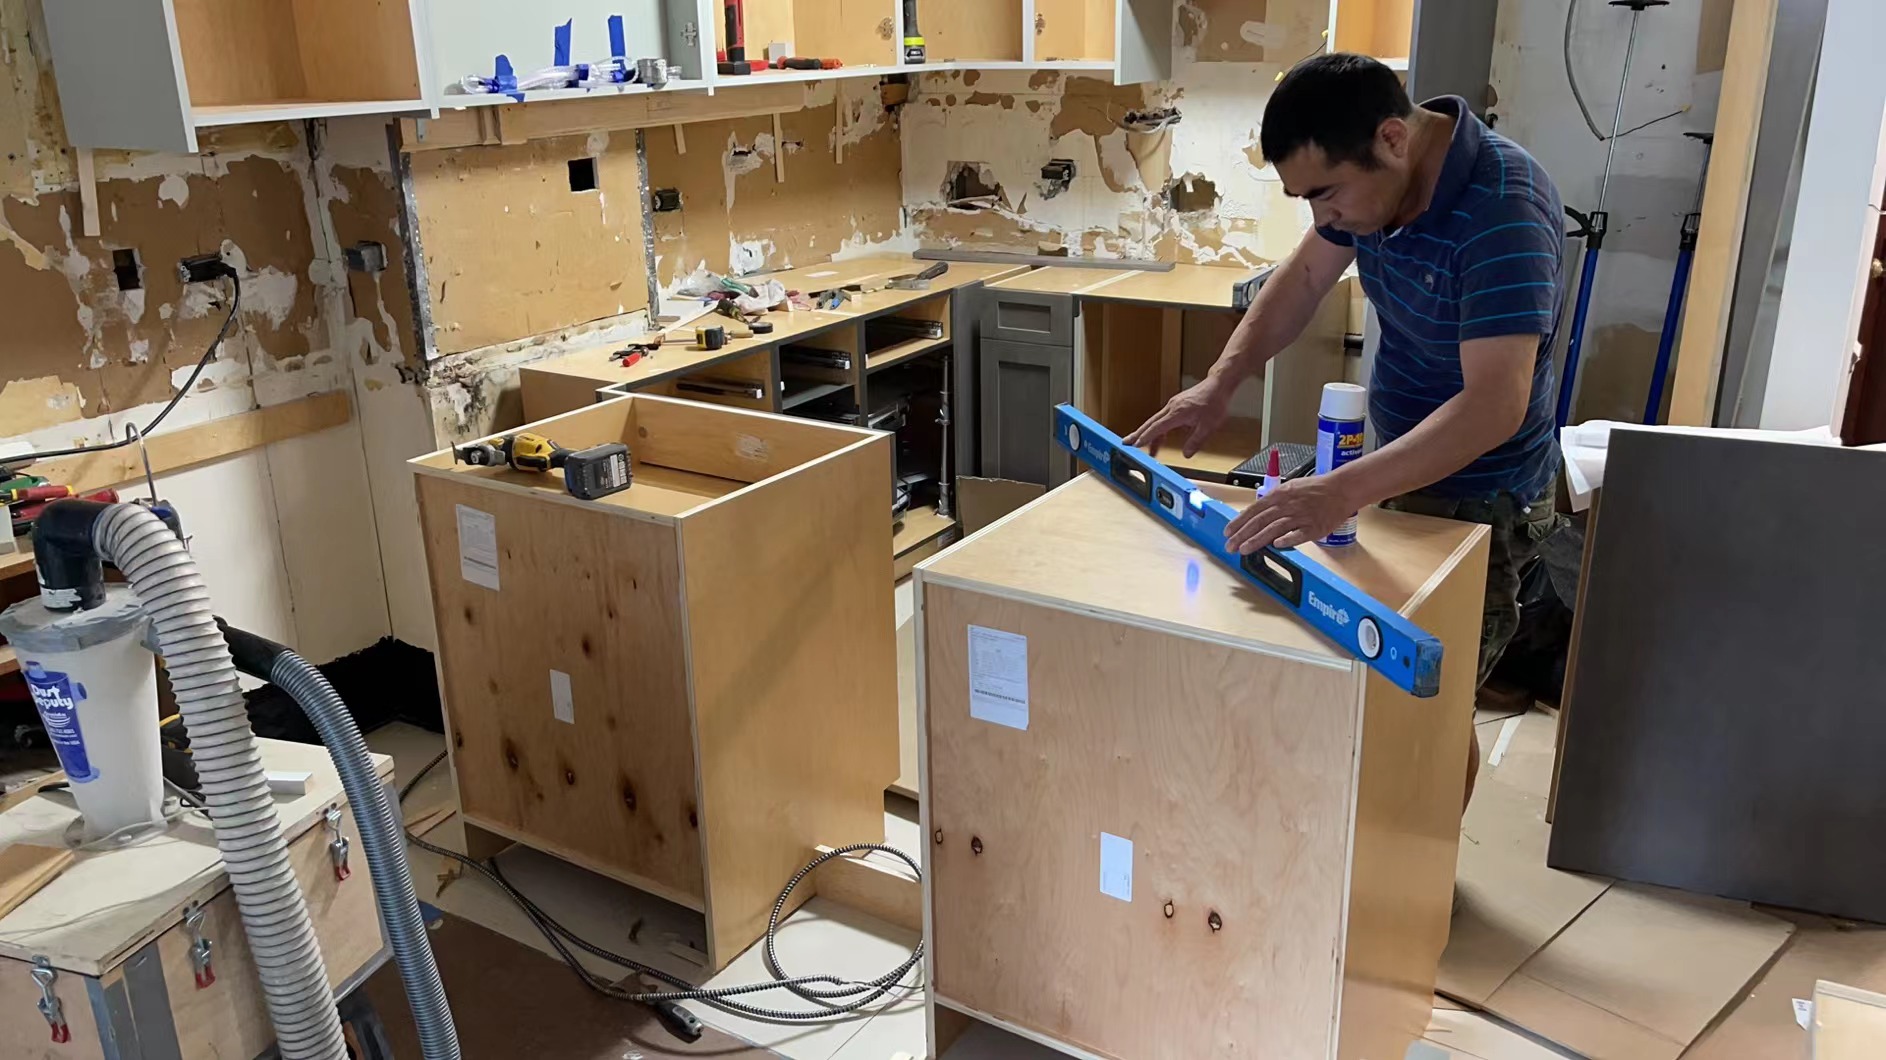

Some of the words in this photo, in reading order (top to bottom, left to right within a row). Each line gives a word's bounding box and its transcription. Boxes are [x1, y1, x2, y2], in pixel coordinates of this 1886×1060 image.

[1308, 590, 1349, 625] Empire
[30, 683, 60, 699] Dust
[34, 697, 74, 710] eputy
